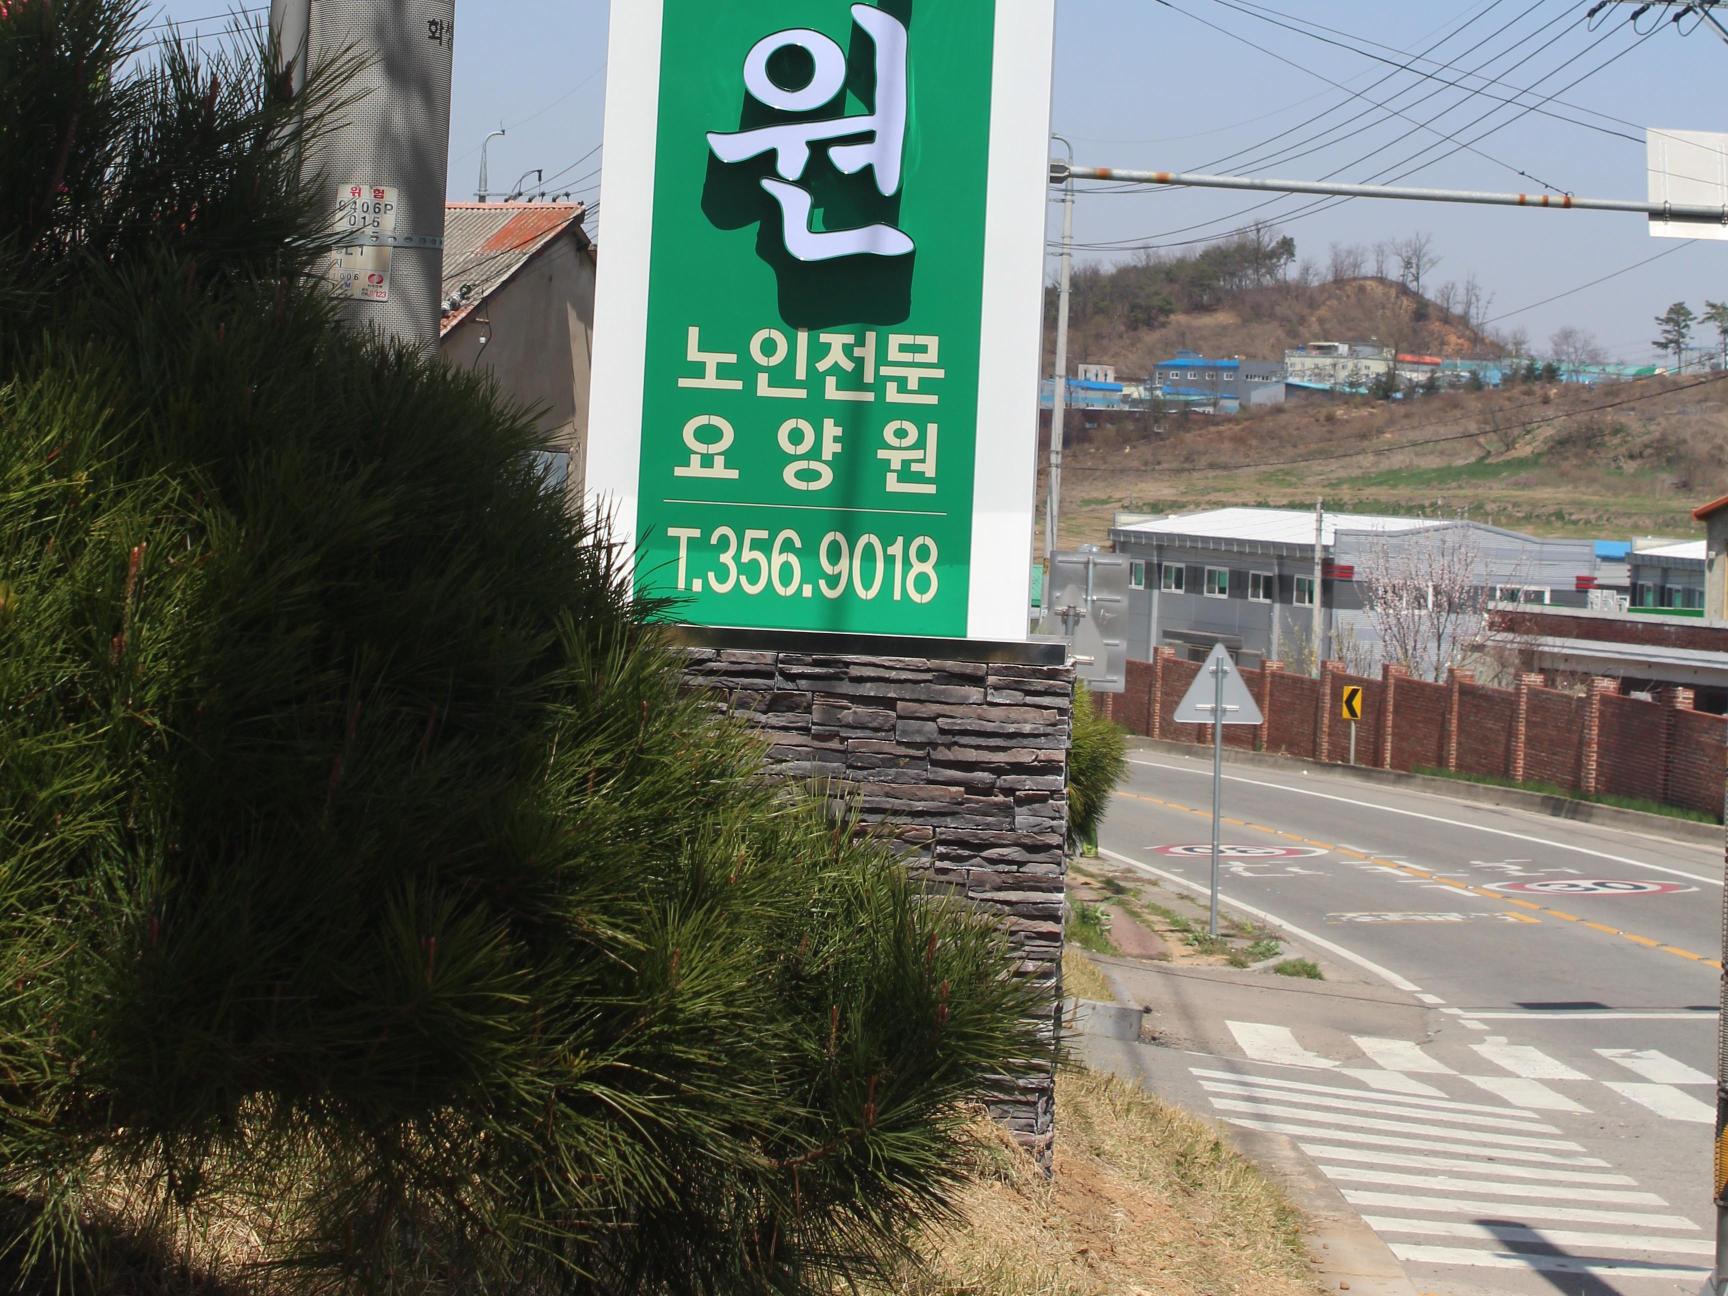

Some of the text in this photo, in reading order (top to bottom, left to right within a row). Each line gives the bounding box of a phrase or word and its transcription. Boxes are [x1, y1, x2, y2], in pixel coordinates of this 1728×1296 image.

[677, 326, 946, 405] 노인전문
[673, 414, 939, 495] 요양원
[666, 525, 940, 604] T.356.9018
